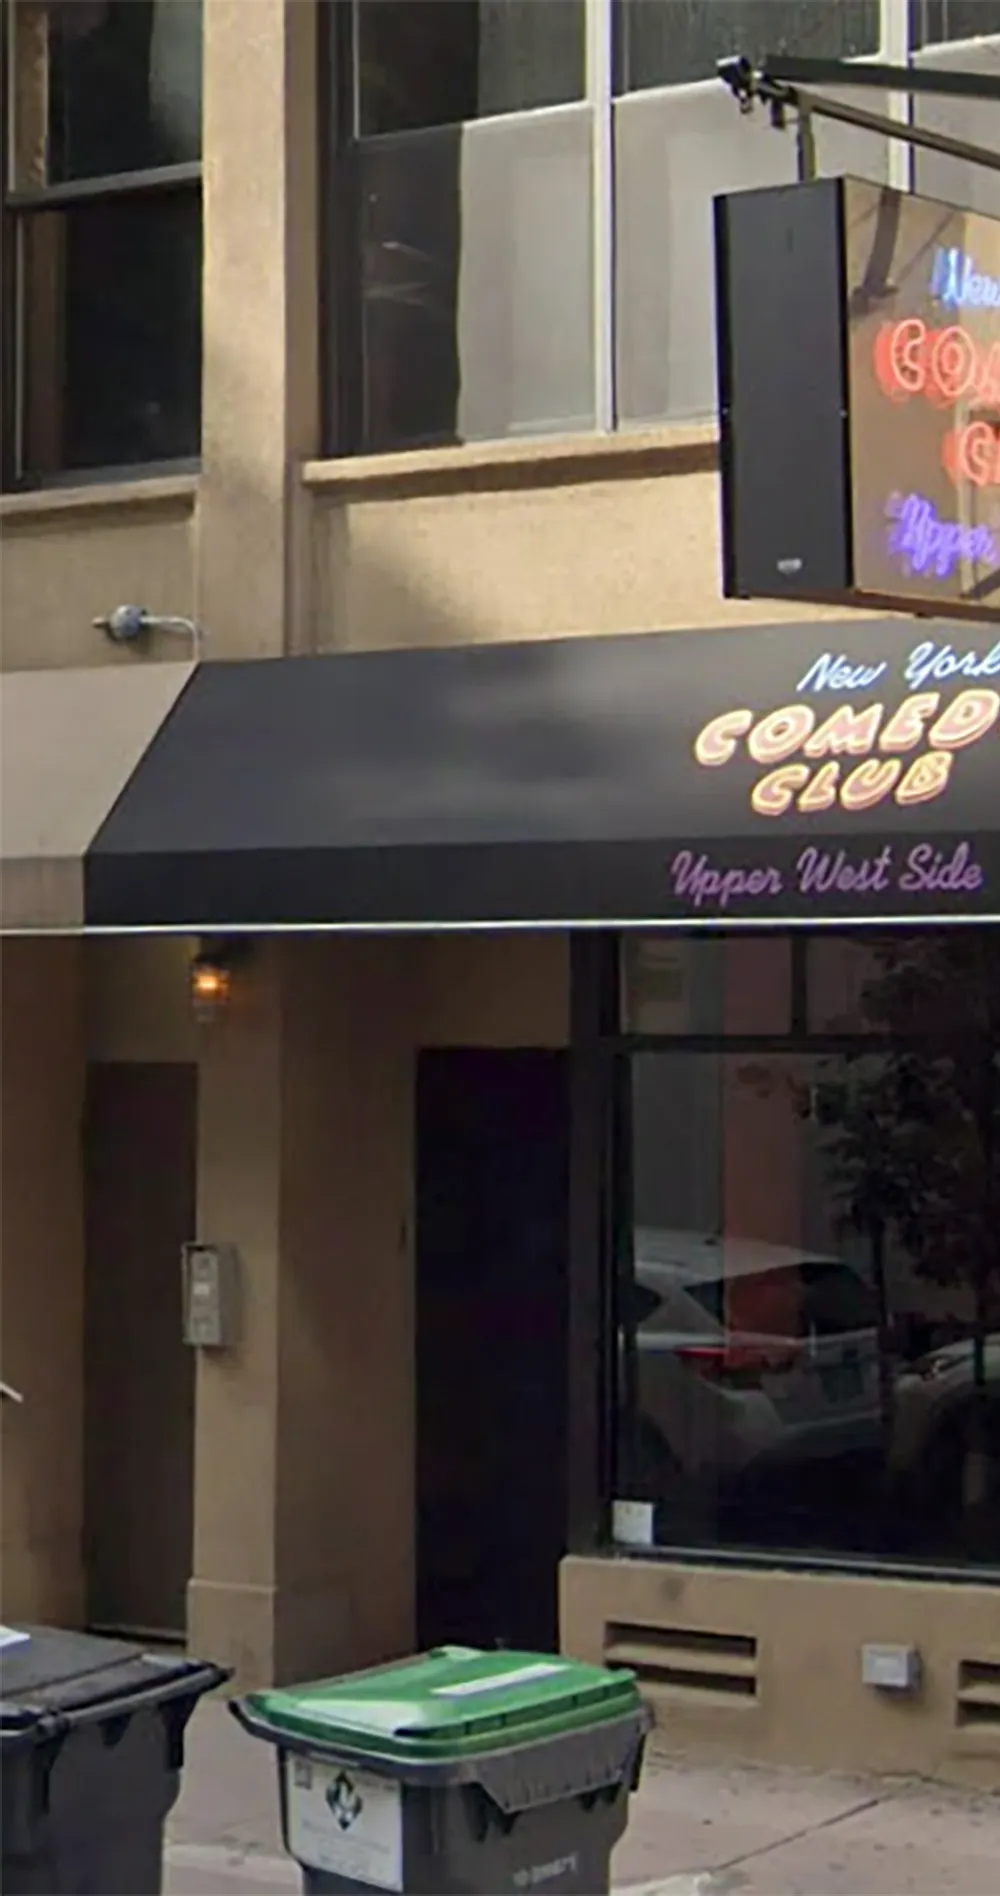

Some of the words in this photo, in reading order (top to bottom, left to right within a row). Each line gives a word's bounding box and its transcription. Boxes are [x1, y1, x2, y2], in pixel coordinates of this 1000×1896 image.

[898, 495, 996, 573] Upper
[797, 653, 888, 692] New
[751, 750, 953, 816] CLUB
[671, 849, 784, 907] Upper
[796, 844, 890, 893] West
[898, 841, 984, 892] Side
